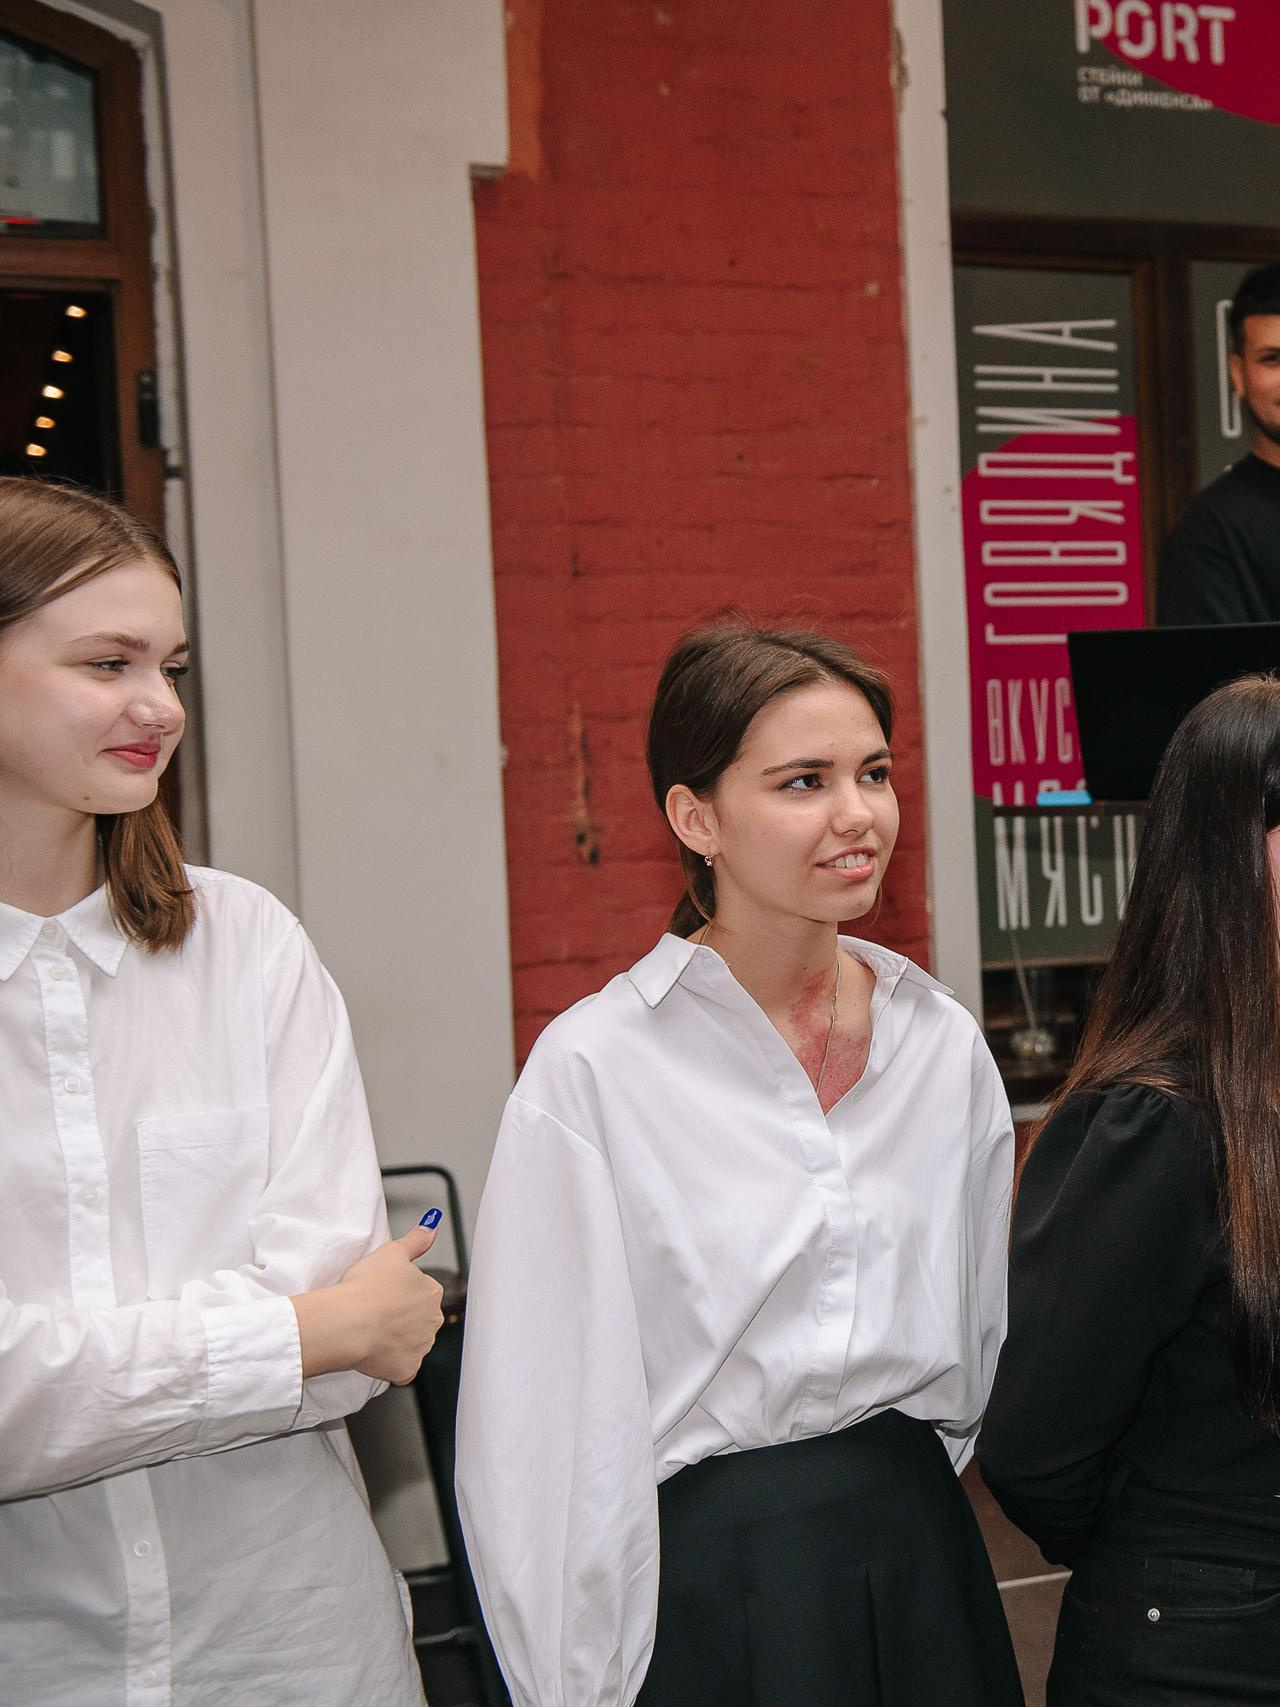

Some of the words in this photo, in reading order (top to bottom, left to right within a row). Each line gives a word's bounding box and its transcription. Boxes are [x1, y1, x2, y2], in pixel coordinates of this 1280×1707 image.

[1074, 0, 1236, 65] PORT
[972, 318, 1135, 645] ГОВЯДИНА
[986, 677, 1074, 766] ВКУС
